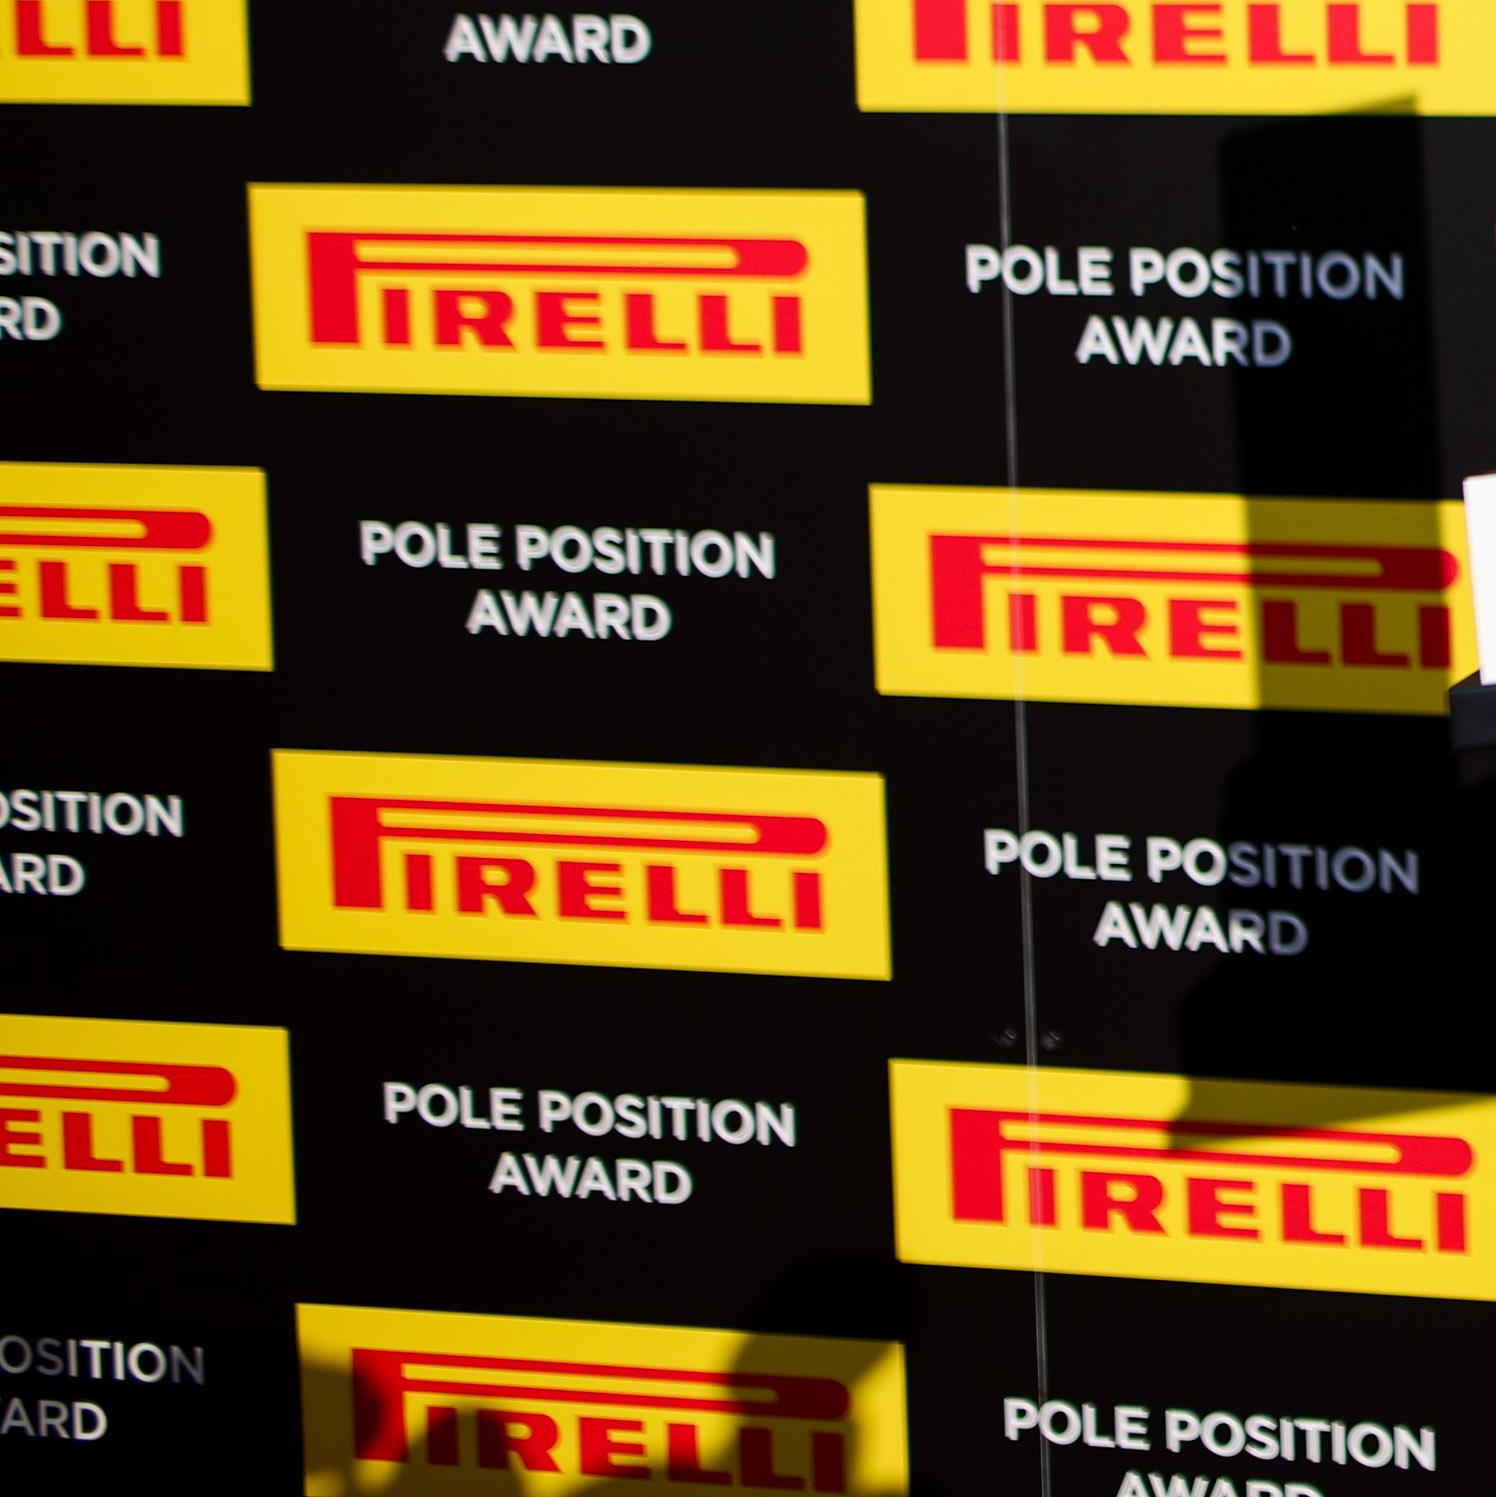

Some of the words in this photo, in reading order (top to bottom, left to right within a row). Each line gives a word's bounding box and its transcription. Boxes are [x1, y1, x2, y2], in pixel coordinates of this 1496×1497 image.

[444, 13, 652, 64] AWARD
[305, 229, 810, 357] PIRELLI
[965, 244, 1114, 296] POLE
[1129, 247, 1404, 300] POSITION
[1075, 315, 1291, 367] AWARD
[360, 520, 503, 570] POLE
[515, 524, 776, 580] POSITION
[466, 589, 671, 641] AWARD
[929, 532, 1461, 671] PIRELLI
[0, 788, 184, 838] SITION
[328, 794, 830, 932] PIRELLI
[983, 828, 1132, 882] POLE
[1146, 836, 1419, 894] POSITION
[1093, 901, 1308, 955] AWARD
[0, 1054, 238, 1179] ELLI
[383, 1081, 524, 1132] POLE
[538, 1090, 796, 1148] POSITION
[489, 1151, 693, 1206] AWARD
[947, 1106, 1475, 1256] PIRELLI
[0, 1334, 205, 1385] OSITION
[0, 1397, 109, 1442] ARD
[350, 1346, 853, 1495] PIRELLI
[1003, 1397, 1151, 1451] POLE
[1165, 1409, 1437, 1472] POSITION
